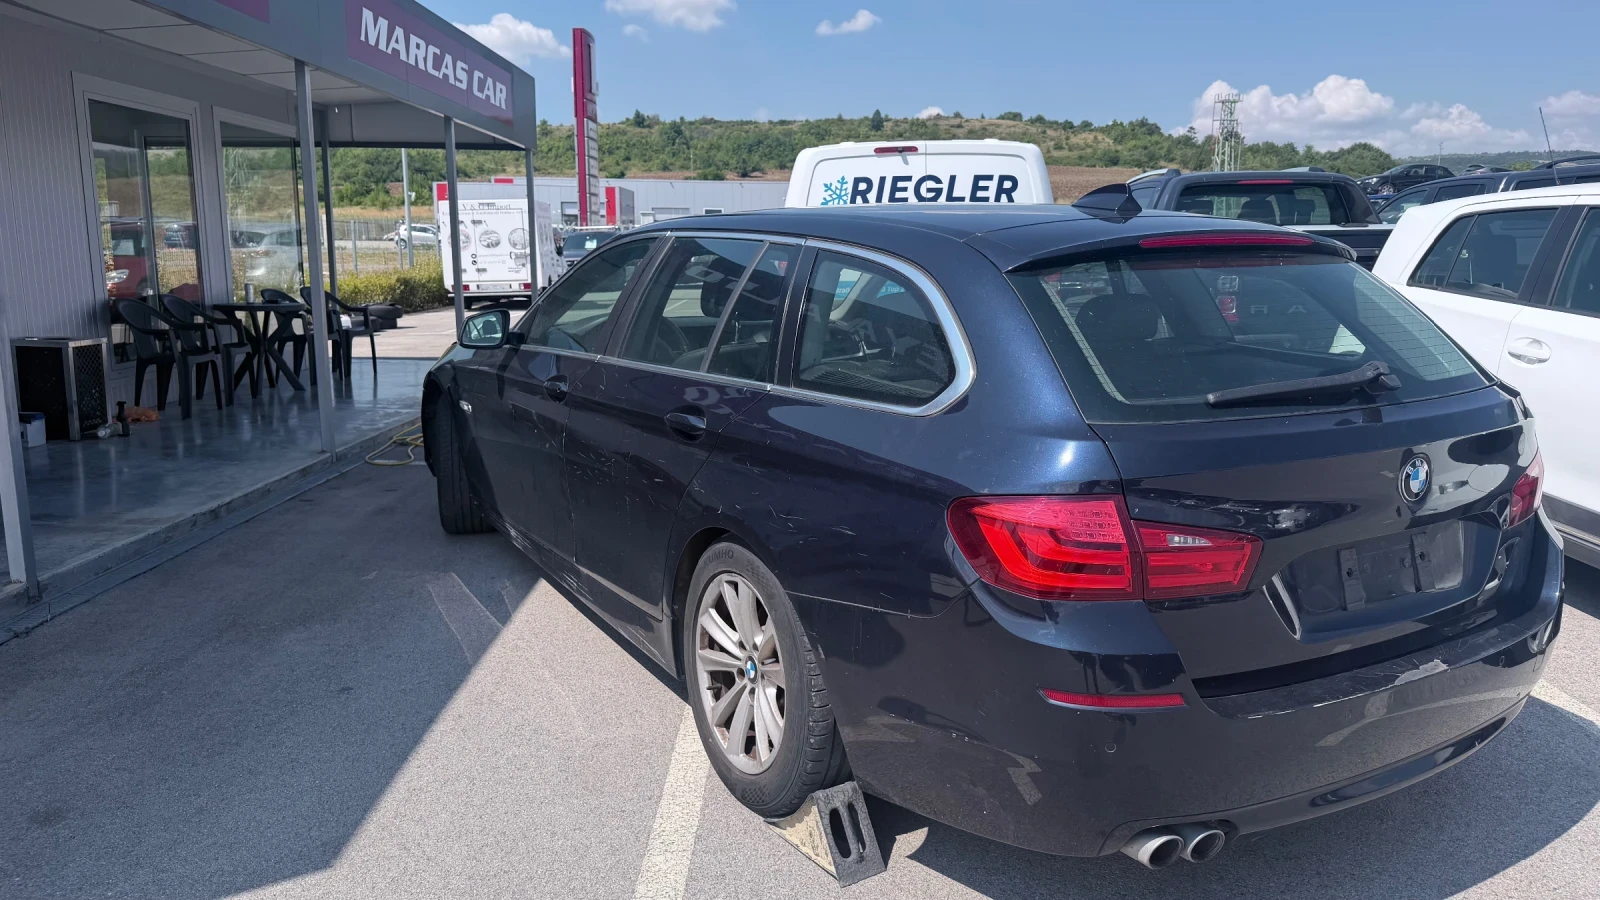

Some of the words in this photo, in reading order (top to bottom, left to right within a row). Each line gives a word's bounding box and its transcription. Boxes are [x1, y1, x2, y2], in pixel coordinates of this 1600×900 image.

[360, 7, 469, 90] MARCAS
[472, 70, 507, 110] CAR
[850, 174, 1019, 203] RIEGLER
[703, 549, 734, 567] KUMHO
